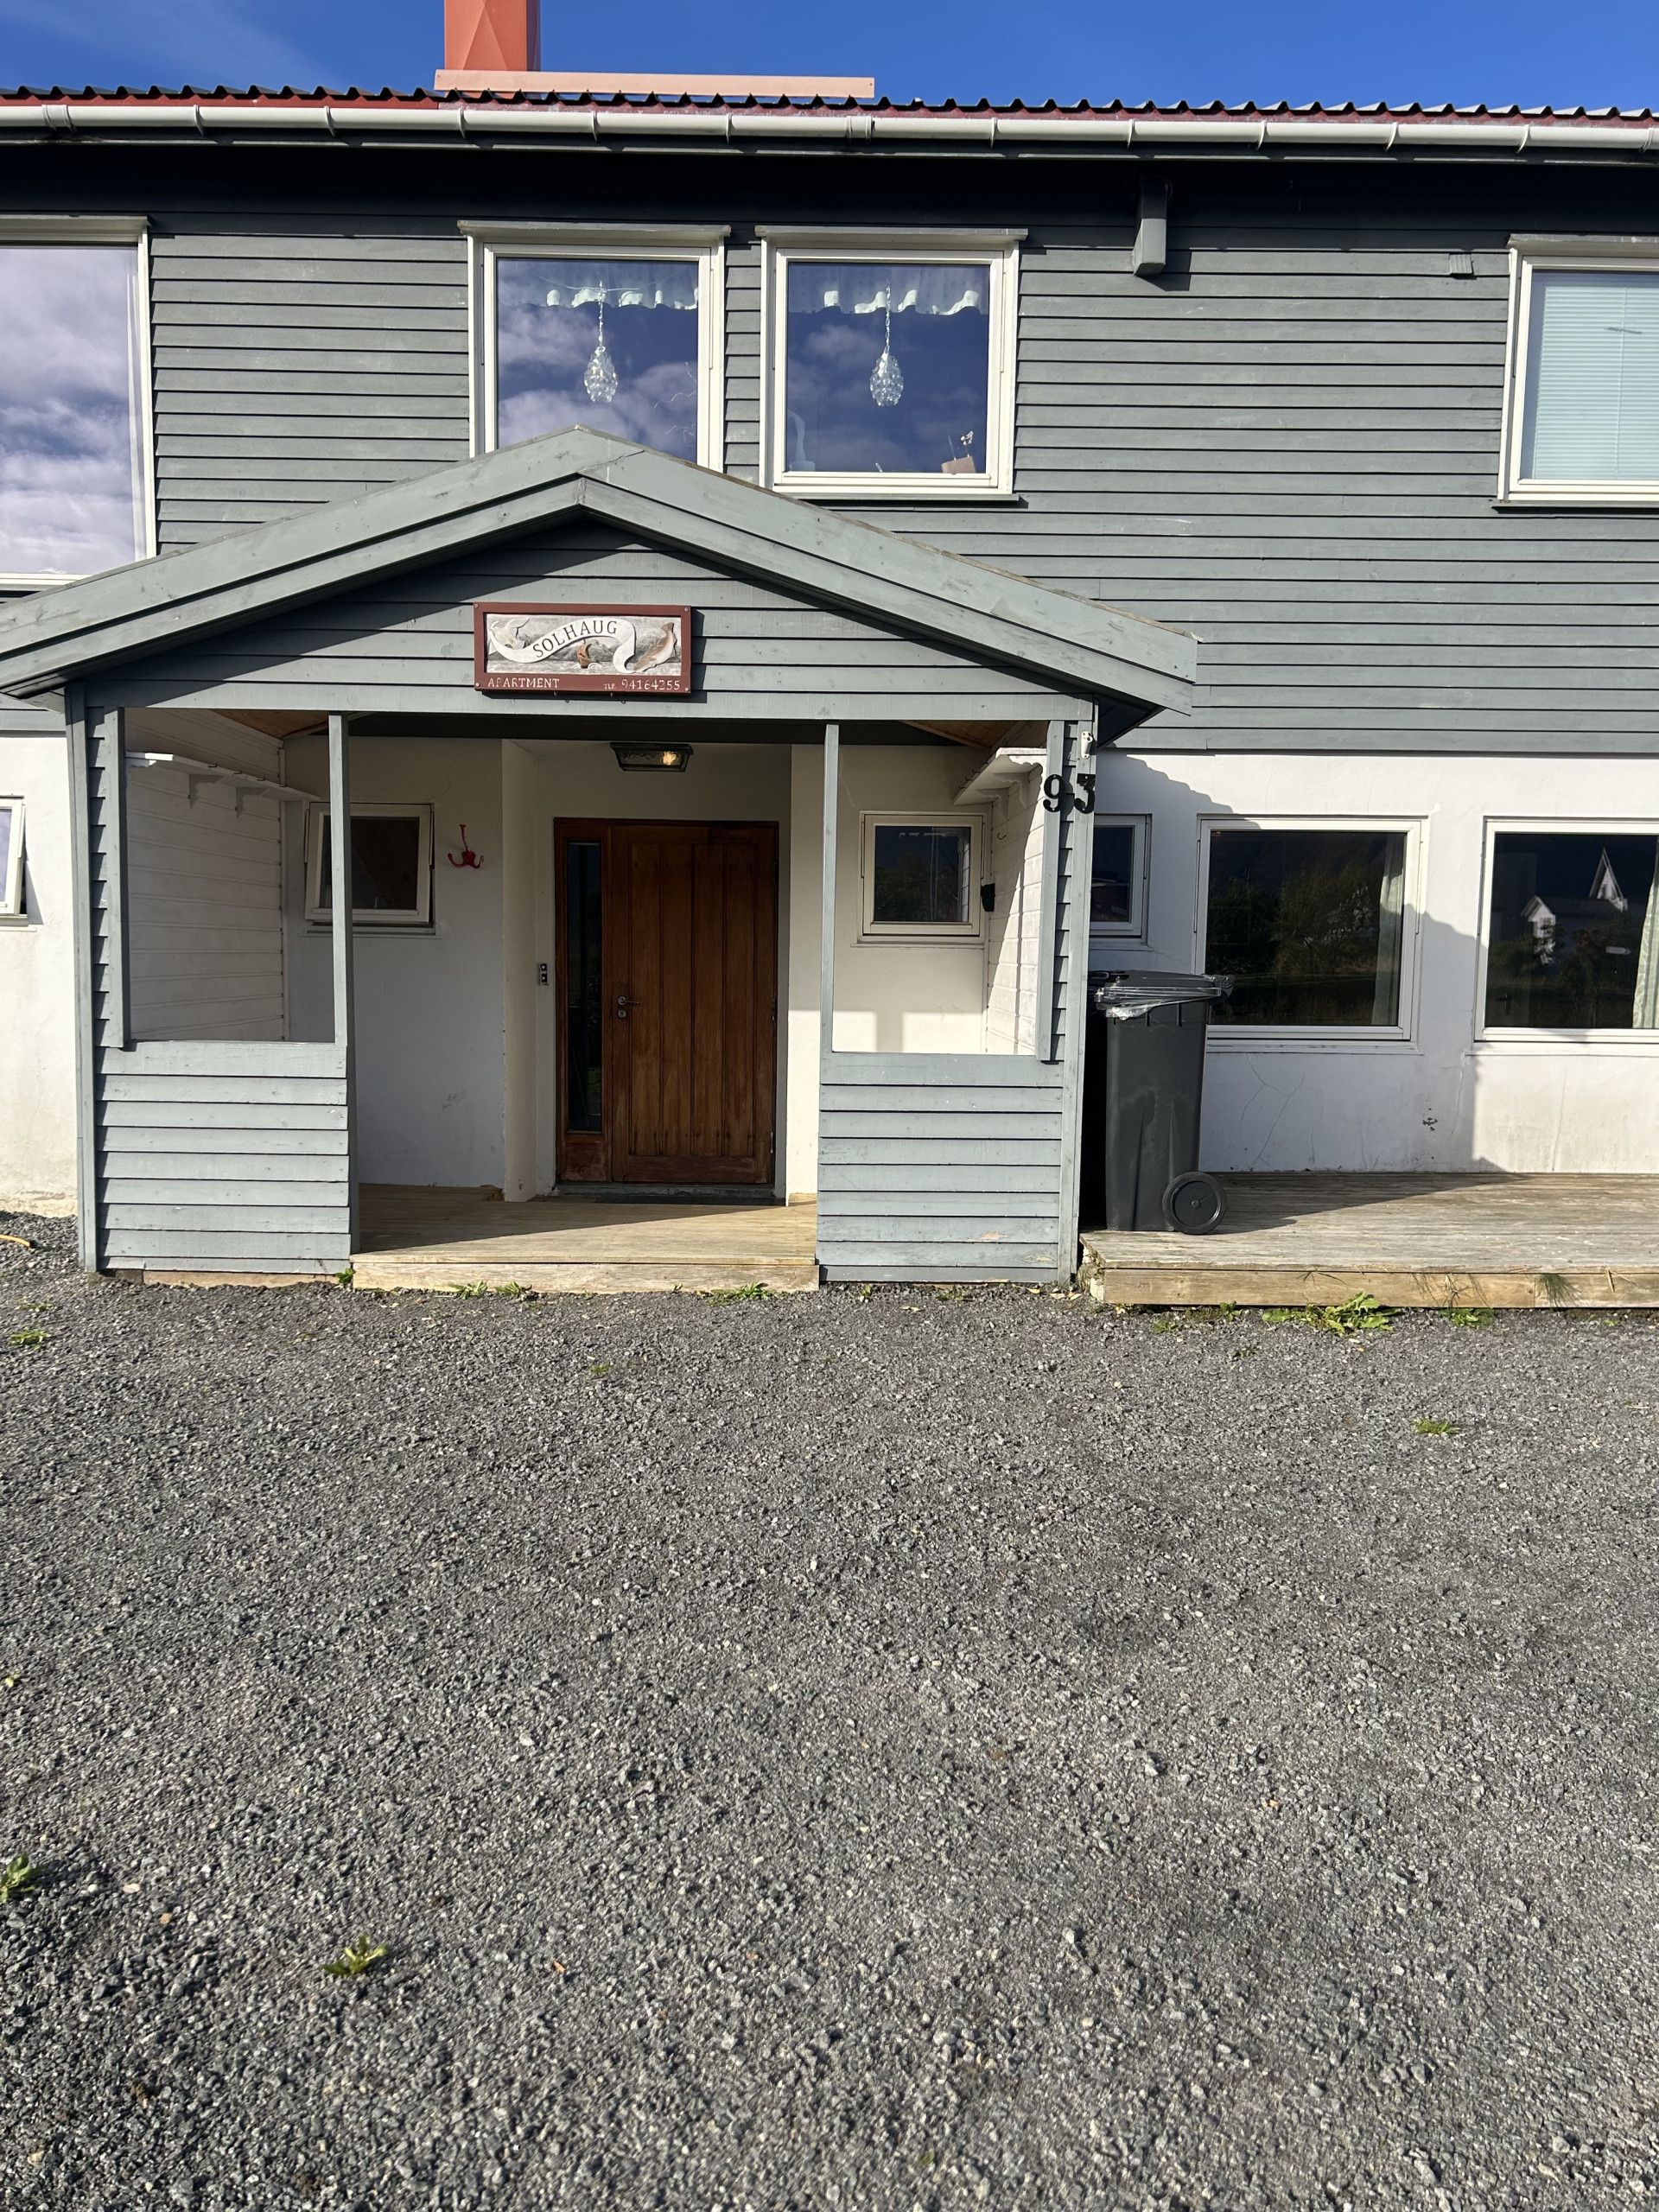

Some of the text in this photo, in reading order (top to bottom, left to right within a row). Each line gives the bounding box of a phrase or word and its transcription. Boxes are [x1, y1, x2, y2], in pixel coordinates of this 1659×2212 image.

[532, 620, 618, 658] SOLHAUG
[487, 677, 560, 689] APARTMENT
[621, 678, 681, 690] 94164255
[1043, 773, 1096, 814] 93
